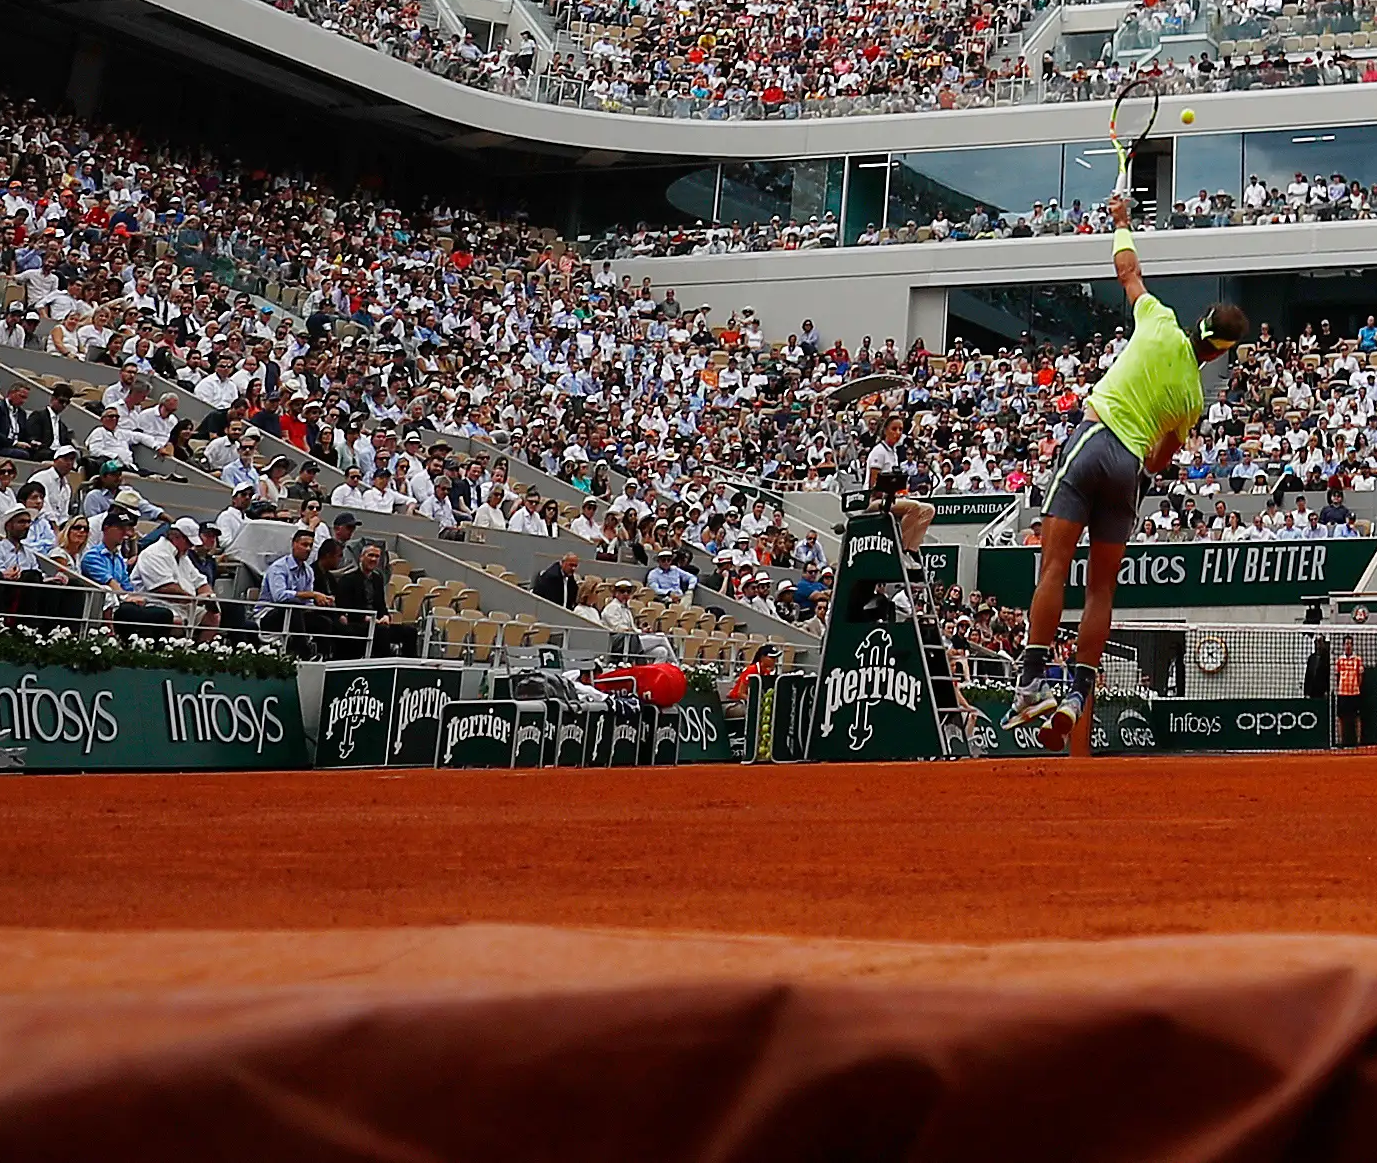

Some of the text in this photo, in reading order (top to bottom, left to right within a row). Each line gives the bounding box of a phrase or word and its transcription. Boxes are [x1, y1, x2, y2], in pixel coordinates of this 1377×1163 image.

[1200, 547, 1240, 583] FLY
[1243, 545, 1327, 583] BETTER
[164, 679, 284, 754] Infosys
[1169, 711, 1222, 736] Infosys
[1235, 711, 1318, 736] oppo
